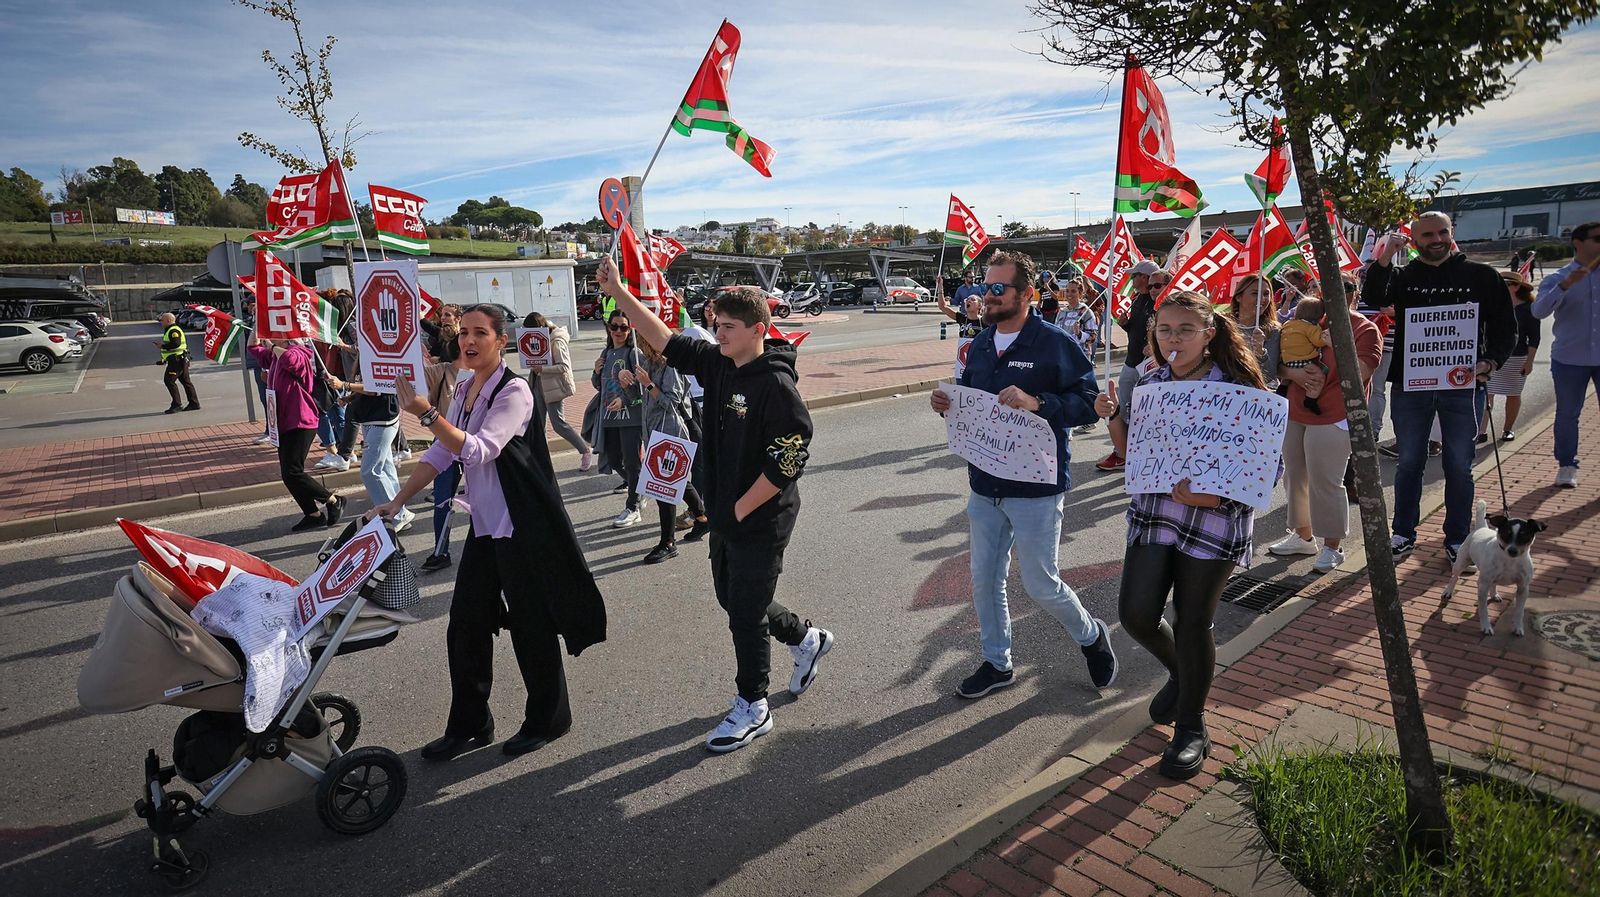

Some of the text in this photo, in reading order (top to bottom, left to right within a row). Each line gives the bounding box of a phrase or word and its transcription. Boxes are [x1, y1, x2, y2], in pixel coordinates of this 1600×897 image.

[381, 278, 405, 296] DOMINGOS
[381, 308, 397, 331] NO
[1410, 309, 1475, 324] QUEREMOS
[1424, 325, 1460, 337] VIVIR,
[1409, 339, 1474, 353] QUEREMOS
[1008, 361, 1034, 369] PATRIOTS
[1410, 355, 1473, 368] CONCILIAR
[374, 366, 403, 376] CCOO
[1137, 394, 1154, 413] MI
[1207, 394, 1233, 411] MI
[959, 392, 1050, 436] LOS DOMINGOS
[956, 422, 1016, 453] EN FAMILIA
[1136, 424, 1258, 454] LOS DOMINGOS
[662, 459, 675, 471] NO
[648, 483, 669, 493] CCOO
[336, 560, 355, 582] NO
[300, 590, 312, 614] CCOO
